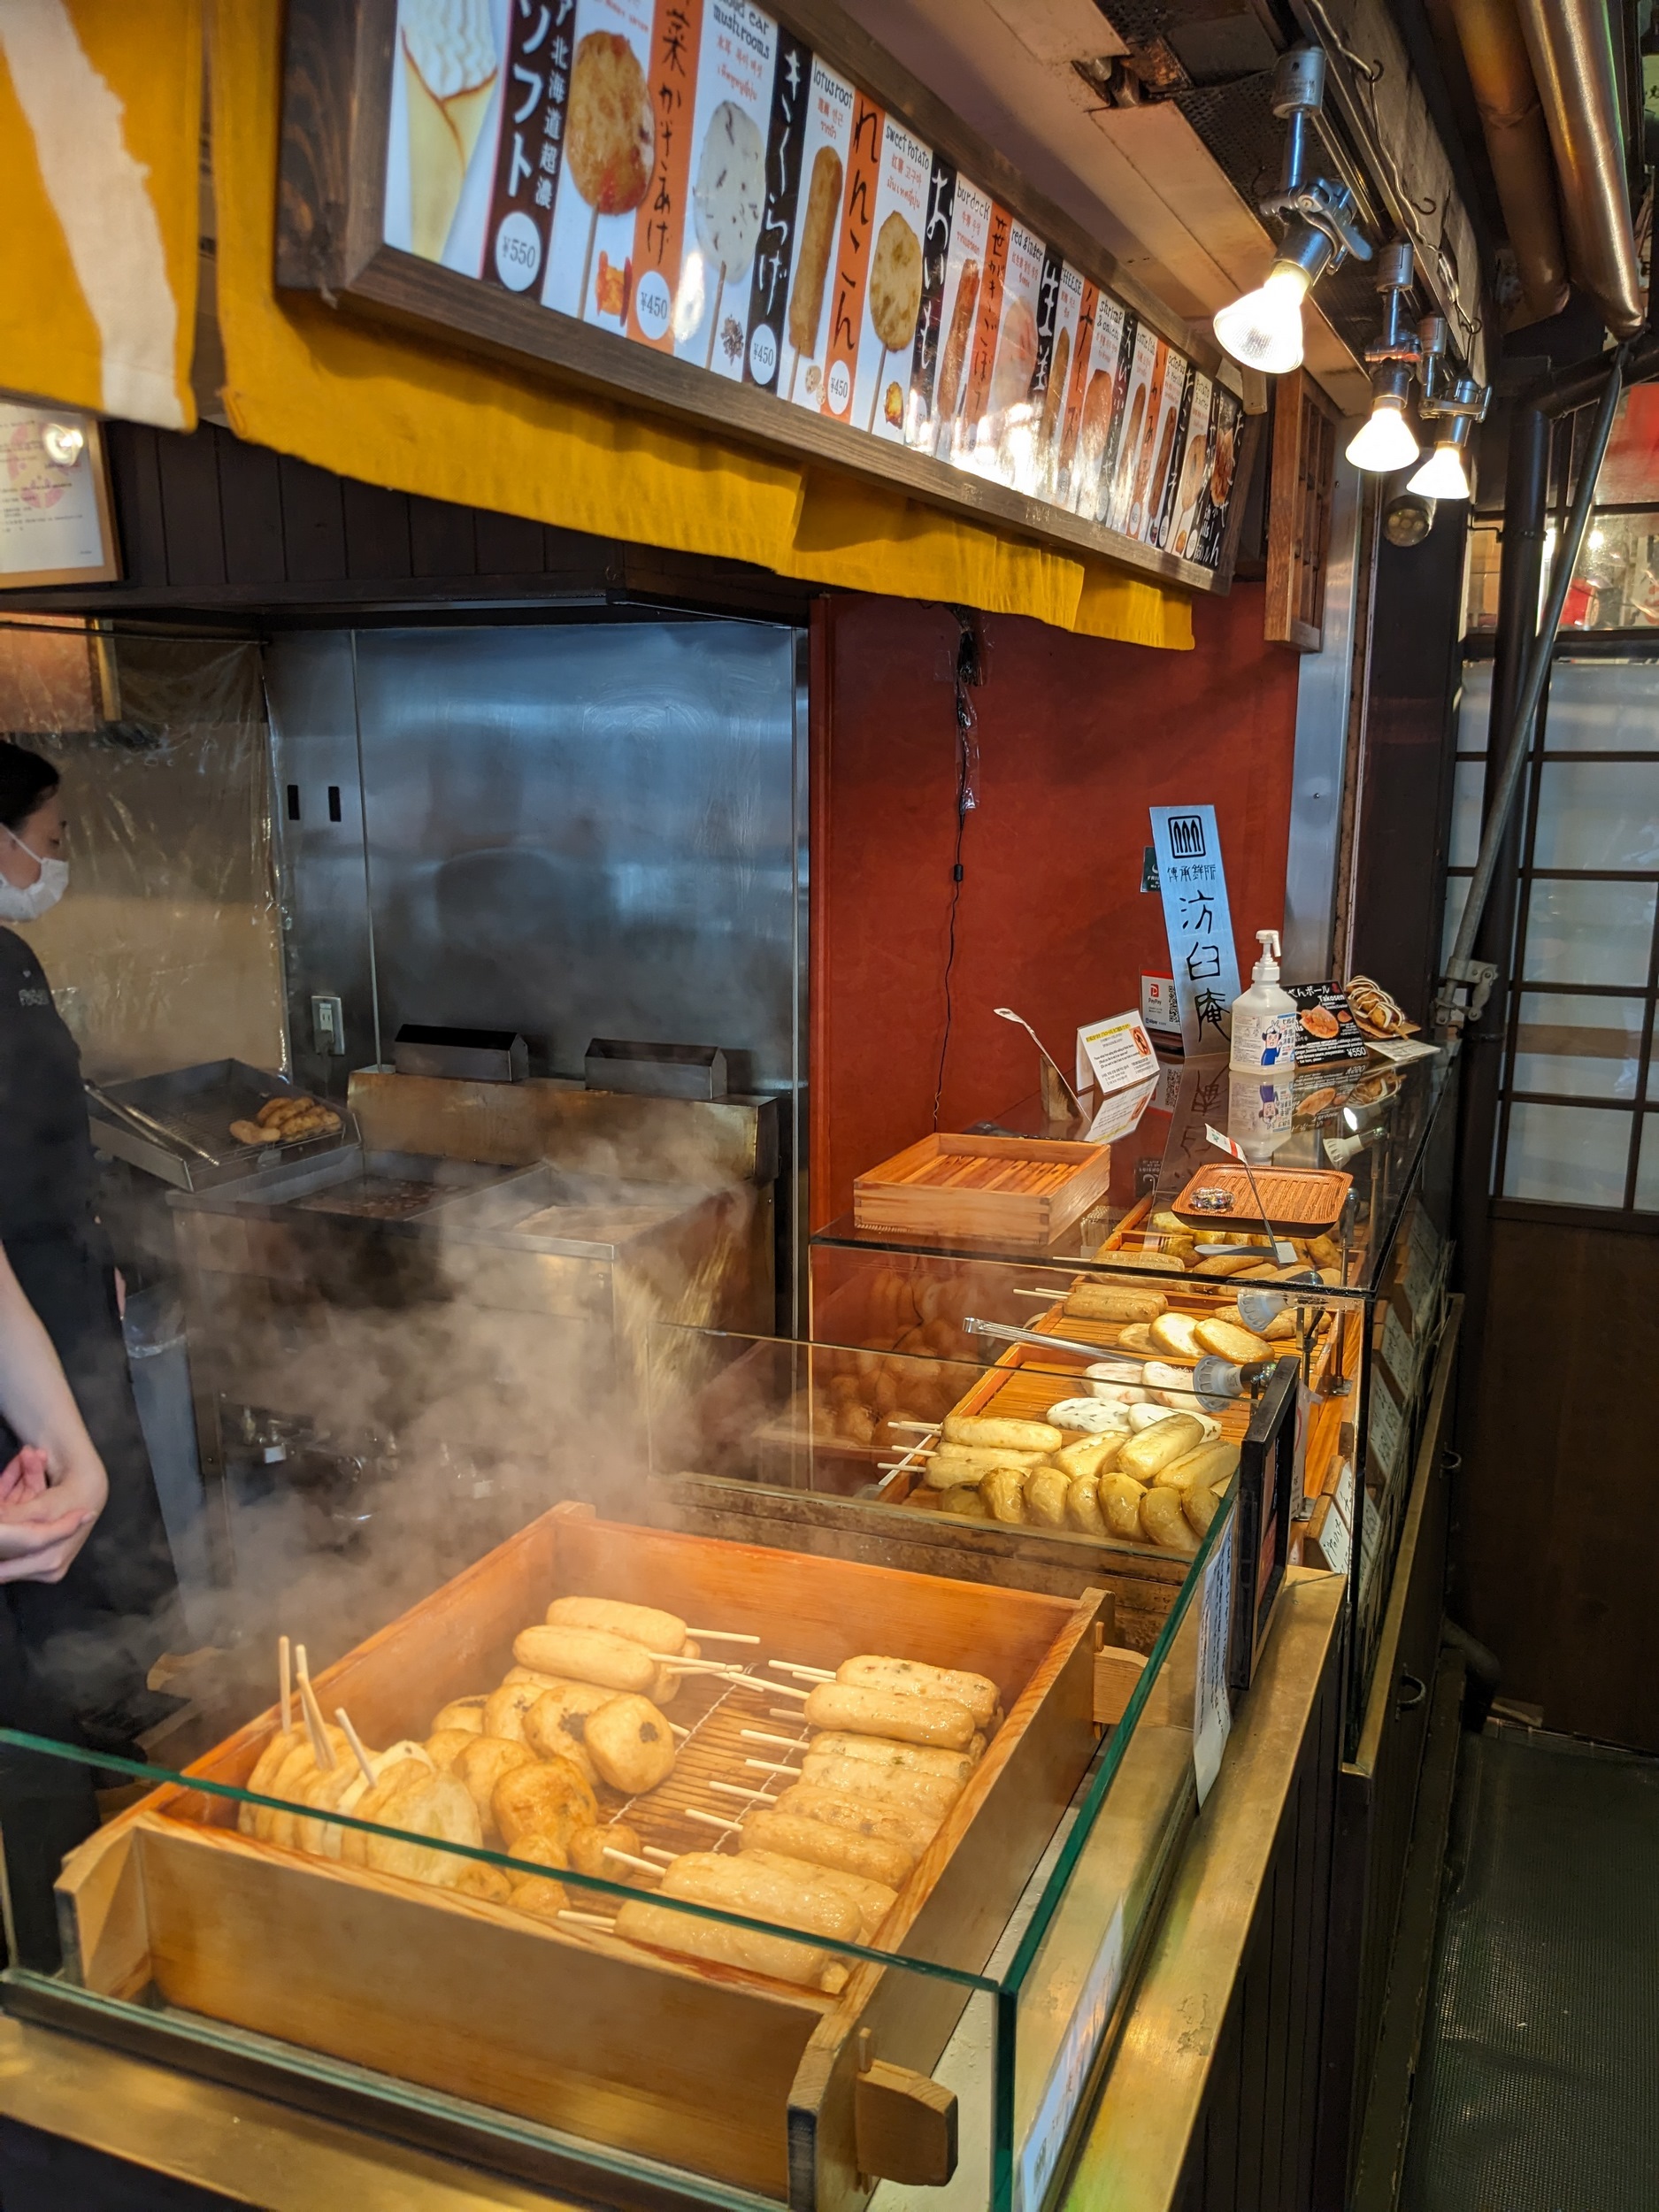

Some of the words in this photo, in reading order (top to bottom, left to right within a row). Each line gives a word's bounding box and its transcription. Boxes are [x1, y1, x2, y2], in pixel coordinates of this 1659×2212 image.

[713, 4, 770, 60] mushrooms
[749, 11, 770, 35] ear
[886, 125, 907, 152] sweet
[502, 236, 536, 269] ¥550
[1011, 228, 1024, 248] red
[1023, 236, 1044, 263] ginger
[641, 291, 668, 320] ¥450
[752, 341, 775, 367] ¥450
[829, 377, 849, 399] ¥450
[1148, 997, 1163, 1006] PayPay
[1317, 994, 1346, 1002] Takosen
[1346, 1046, 1367, 1057] ¥550
